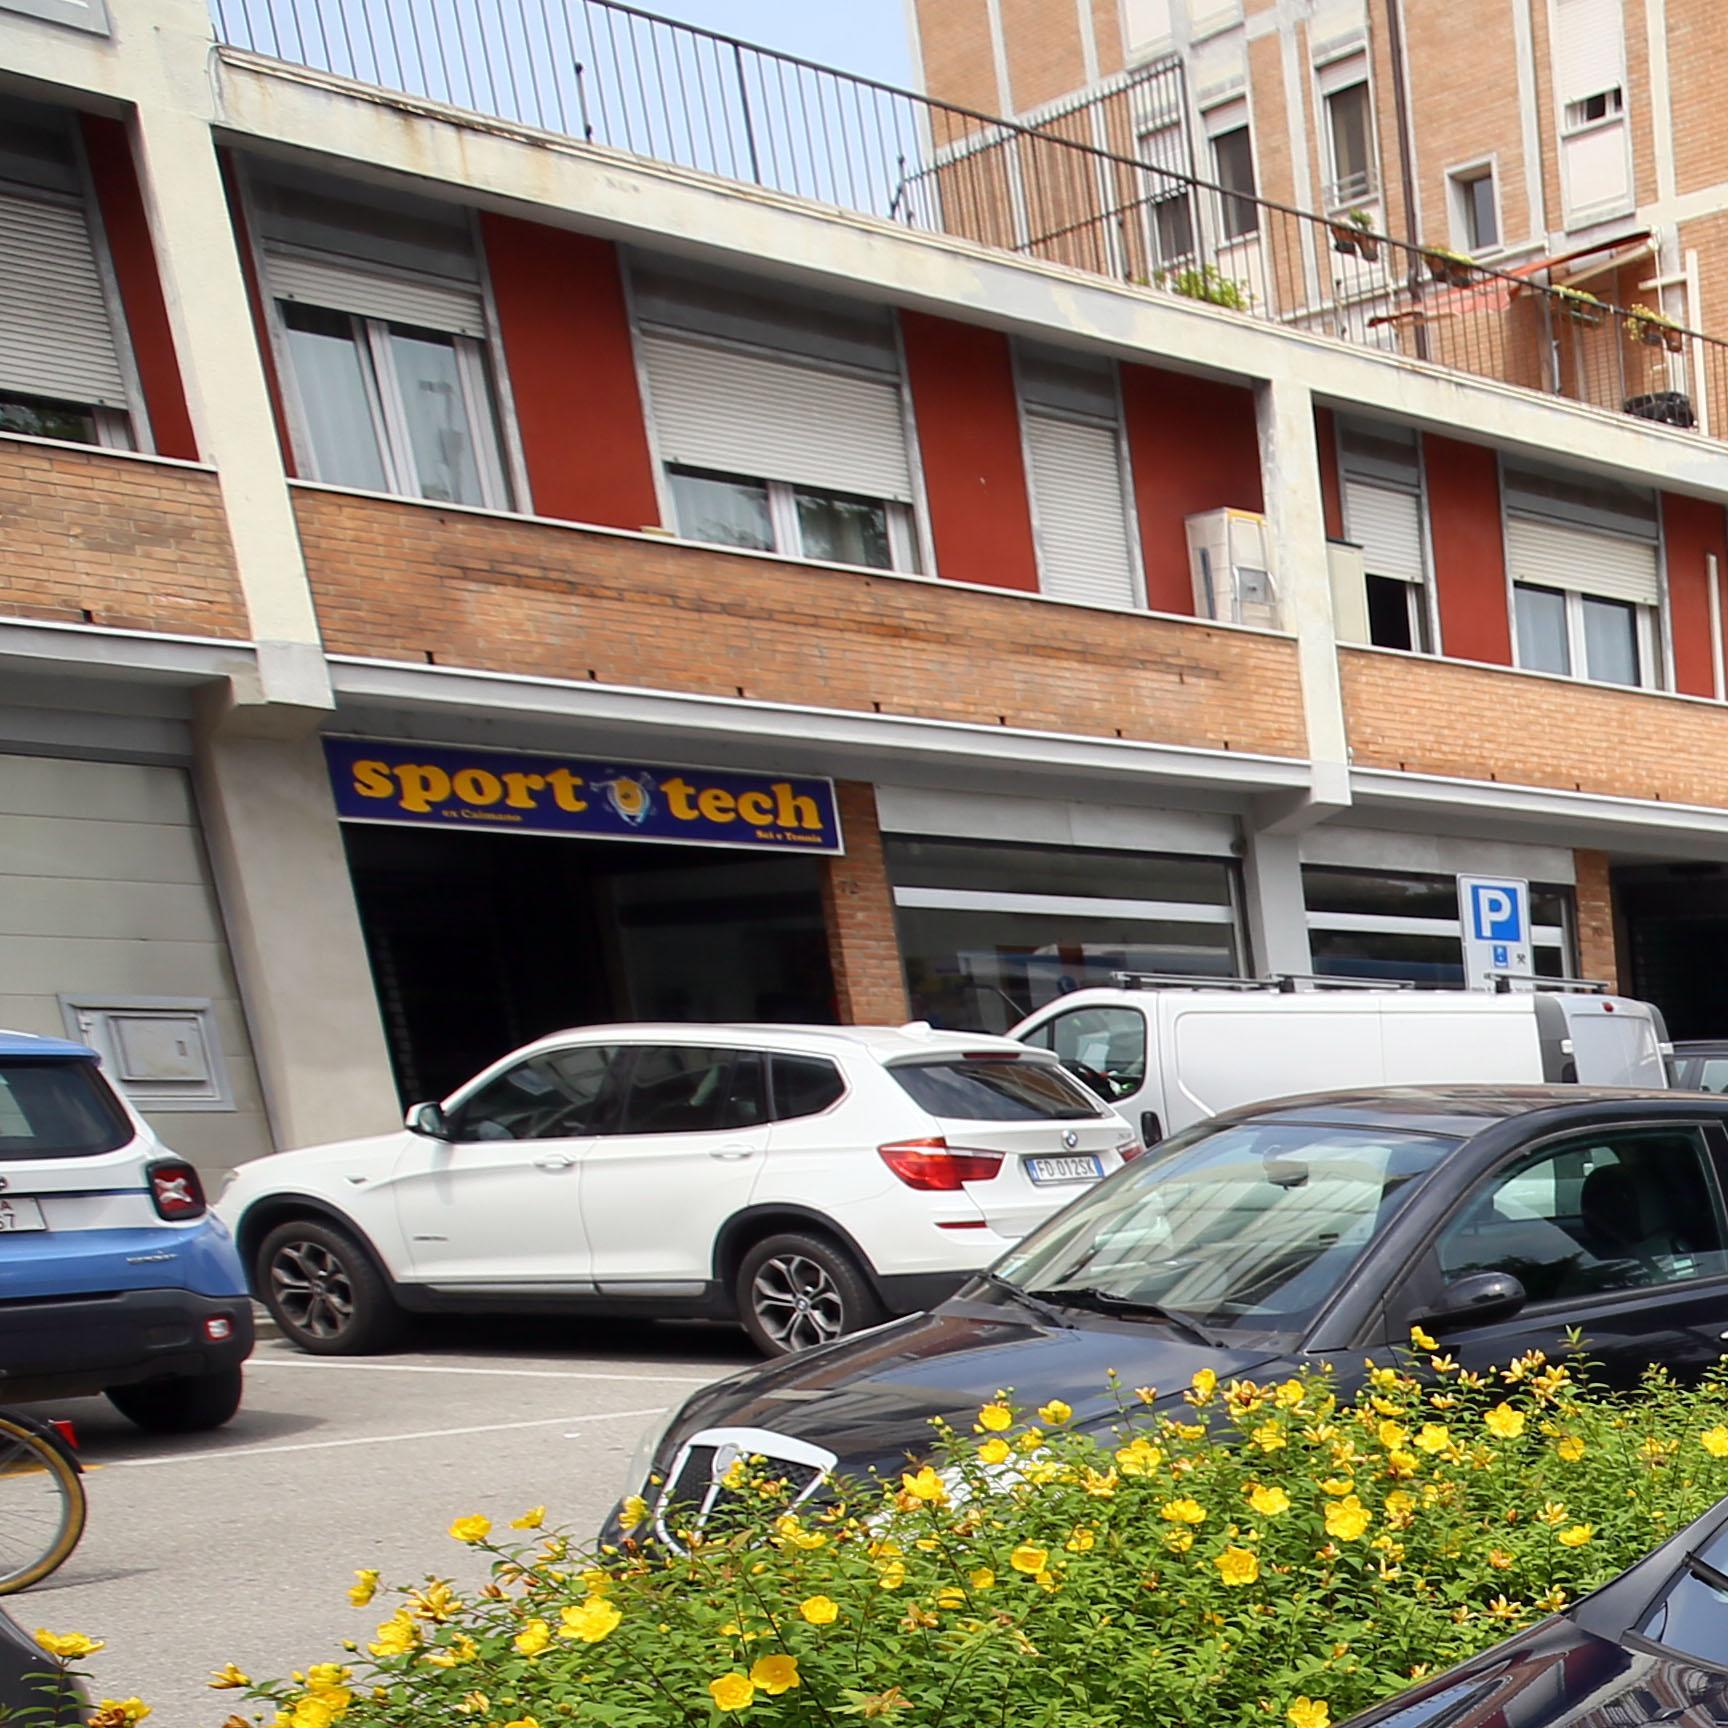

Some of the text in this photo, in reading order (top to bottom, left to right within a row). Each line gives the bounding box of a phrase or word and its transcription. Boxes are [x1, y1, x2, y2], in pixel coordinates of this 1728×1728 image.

[352, 759, 823, 830] sport tech
[1478, 887, 1512, 937] P
